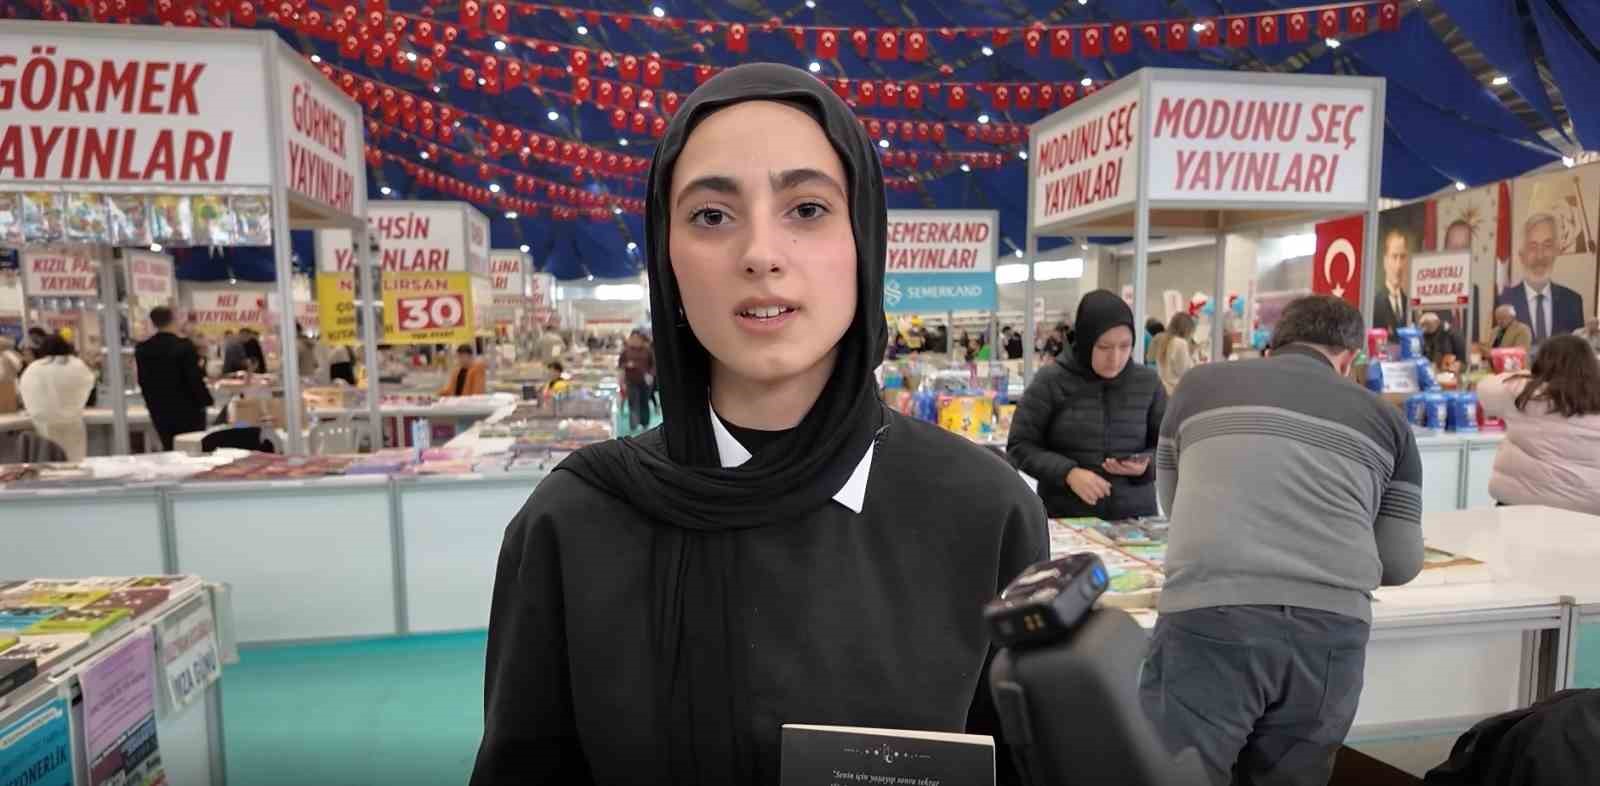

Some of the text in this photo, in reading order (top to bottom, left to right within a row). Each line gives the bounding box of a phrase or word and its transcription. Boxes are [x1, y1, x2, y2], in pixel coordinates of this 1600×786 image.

[1038, 101, 1137, 177] MODUNU SEÇ
[1153, 97, 1364, 150] MODUNU SEÇ
[1043, 157, 1122, 216] YAYINLARI
[1174, 150, 1340, 193] YAYINLARI
[888, 249, 978, 269] YAYINLARI
[401, 296, 462, 329] 30
[907, 285, 982, 297] SEMERKAND
